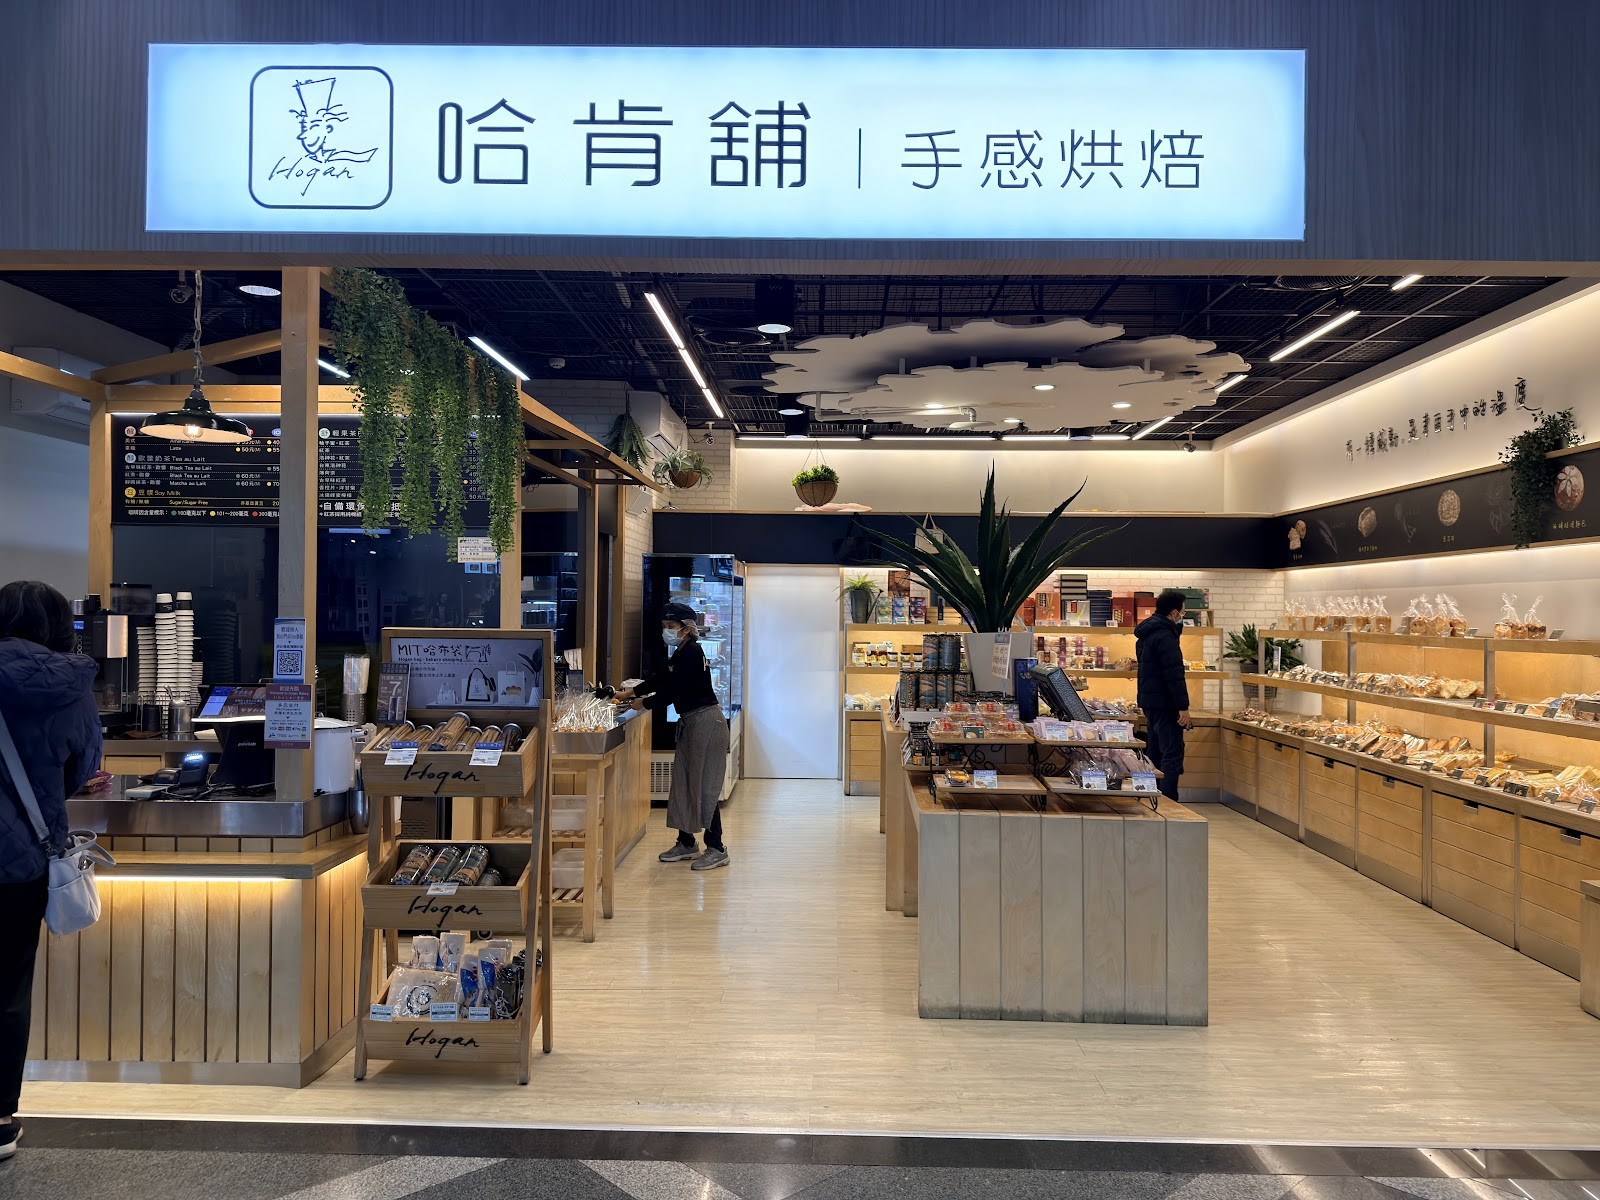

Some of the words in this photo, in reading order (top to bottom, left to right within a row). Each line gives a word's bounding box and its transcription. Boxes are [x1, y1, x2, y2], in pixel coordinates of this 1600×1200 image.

[438, 98, 811, 188] 哈肯舖
[900, 129, 1204, 189] 手感烘焙
[268, 156, 354, 196] Hogan
[389, 681, 402, 696] 7
[404, 761, 480, 794] Hogan
[408, 896, 483, 928] Hogan
[406, 1027, 479, 1058] Hogan
